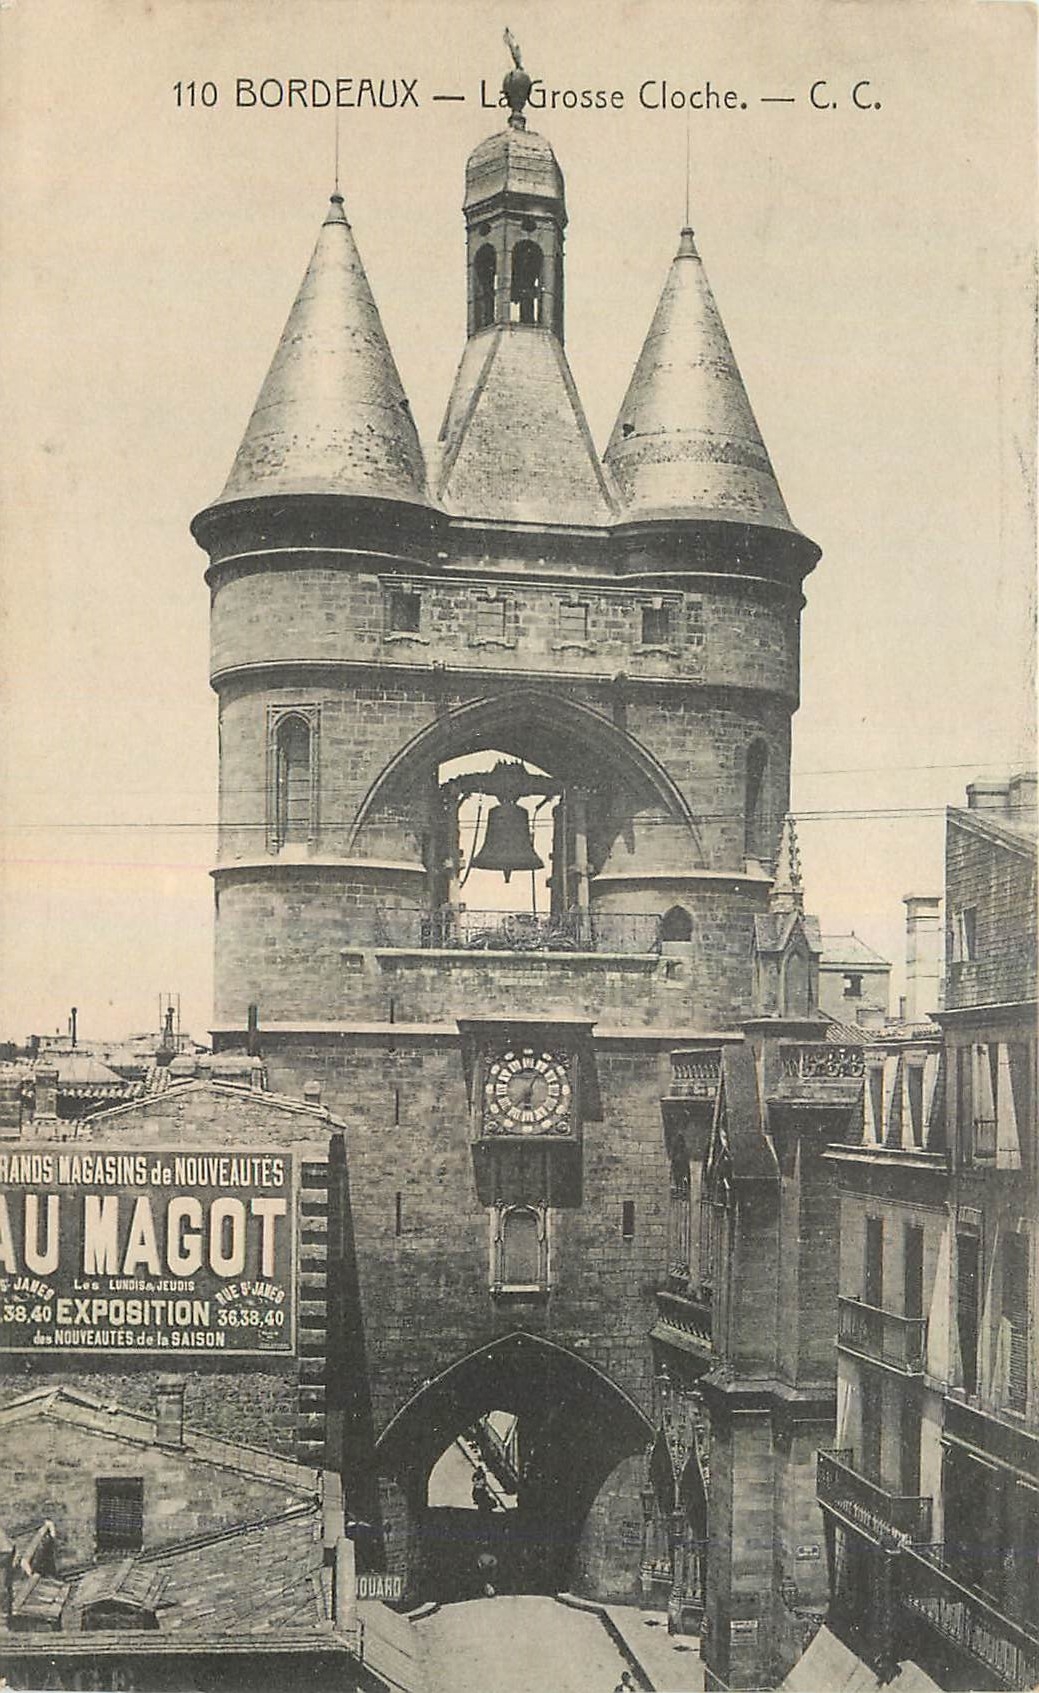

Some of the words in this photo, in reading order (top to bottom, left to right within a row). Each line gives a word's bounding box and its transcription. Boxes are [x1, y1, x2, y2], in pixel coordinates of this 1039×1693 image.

[59, 1155, 147, 1186] MAGASINS
[151, 1160, 171, 1186] de
[175, 1154, 284, 1187] NOUVEAUTÉS
[84, 1195, 287, 1277] MAGOT
[156, 1280, 195, 1291] JEUDIS
[214, 1284, 240, 1306] RUE
[251, 1281, 285, 1304] JAMES
[57, 1298, 210, 1327] EXPOSITION
[55, 1327, 134, 1346] NOUVEAUTÉS
[137, 1331, 154, 1346] de
[157, 1330, 169, 1346] la
[171, 1331, 226, 1347] SAISON
